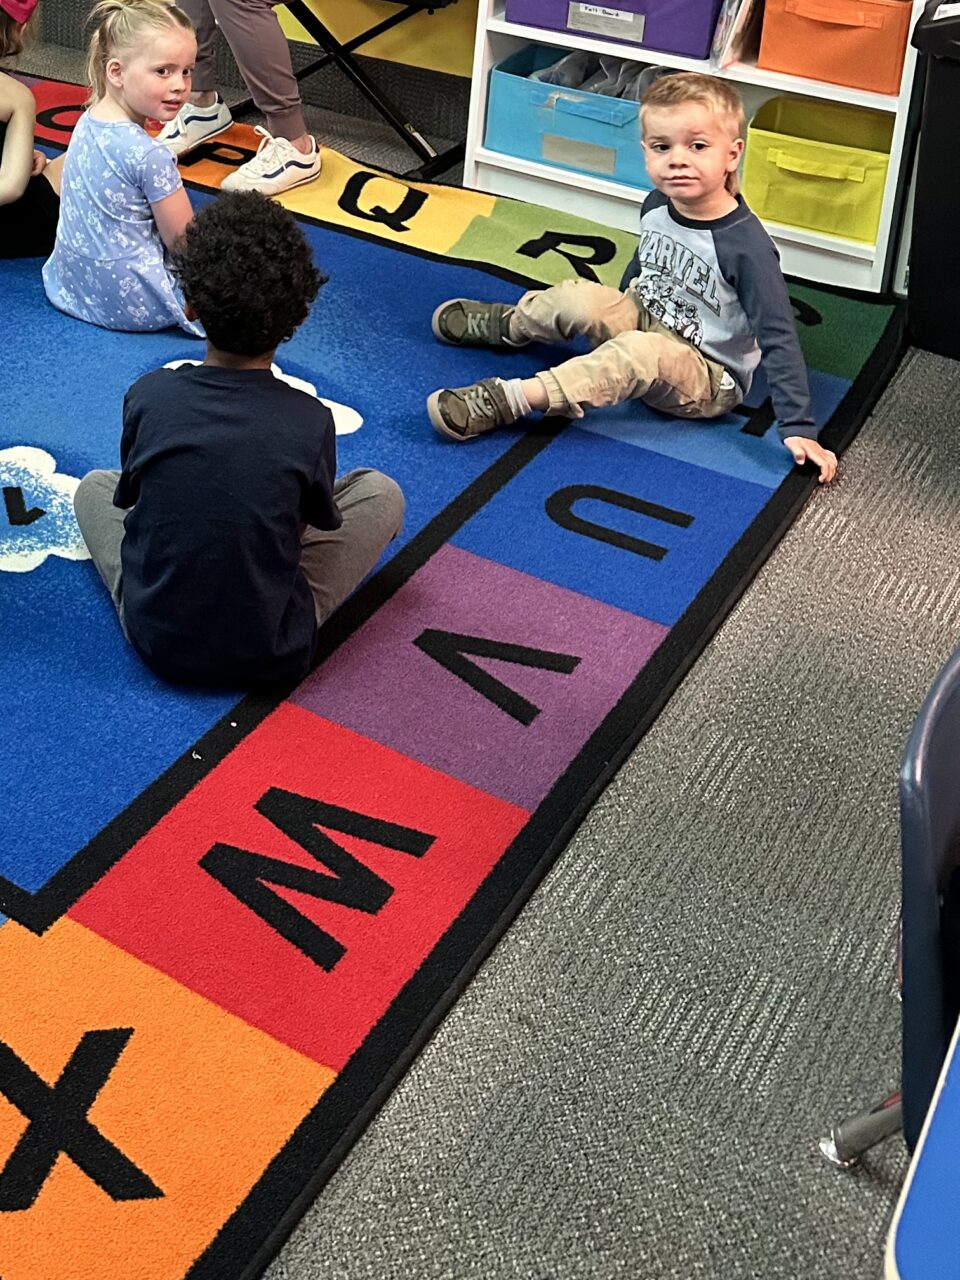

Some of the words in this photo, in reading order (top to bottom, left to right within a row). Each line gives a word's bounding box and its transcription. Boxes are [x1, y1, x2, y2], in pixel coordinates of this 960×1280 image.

[337, 169, 430, 232] Q
[515, 231, 617, 284] R
[544, 483, 696, 562] U
[411, 628, 583, 728] V
[197, 786, 438, 974] W
